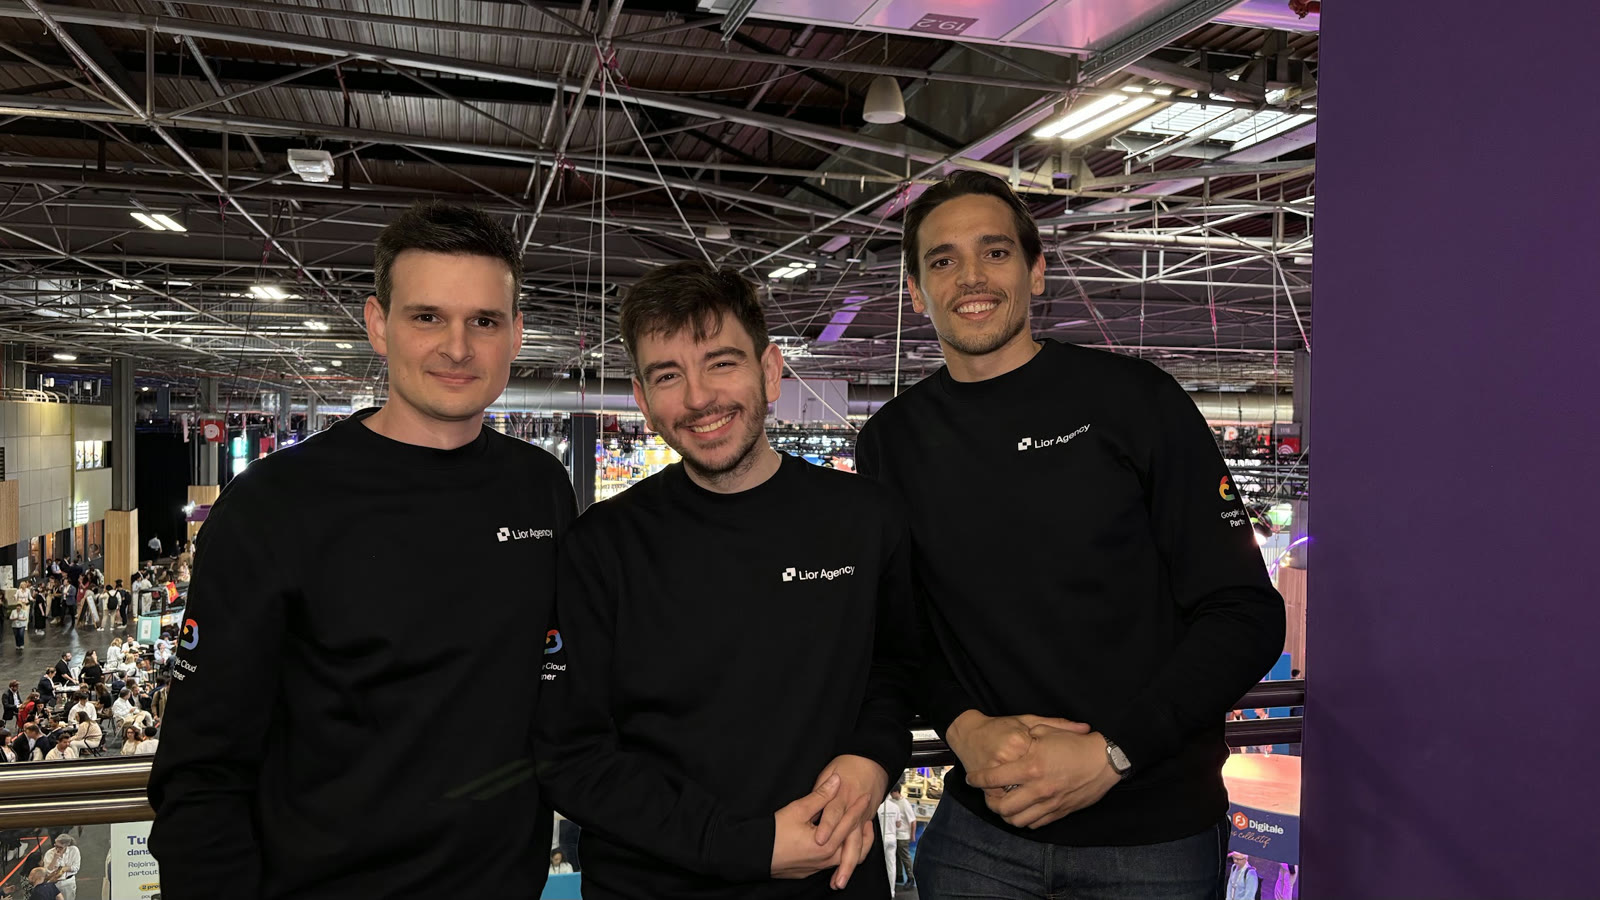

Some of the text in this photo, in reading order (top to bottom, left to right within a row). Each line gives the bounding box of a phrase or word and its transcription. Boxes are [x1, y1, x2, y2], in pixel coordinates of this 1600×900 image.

[917, 18, 966, 31] 19.2
[1034, 423, 1091, 449] Lior Agency
[512, 528, 553, 540] Lior Agency
[799, 565, 855, 581] Lior Agency
[180, 659, 198, 673] Cloud
[545, 662, 567, 672] Cloud
[541, 673, 557, 681] ner
[1249, 820, 1284, 835] Digitale
[127, 835, 147, 845] Tu
[128, 861, 156, 869] Rejoins
[128, 869, 159, 878] partout
